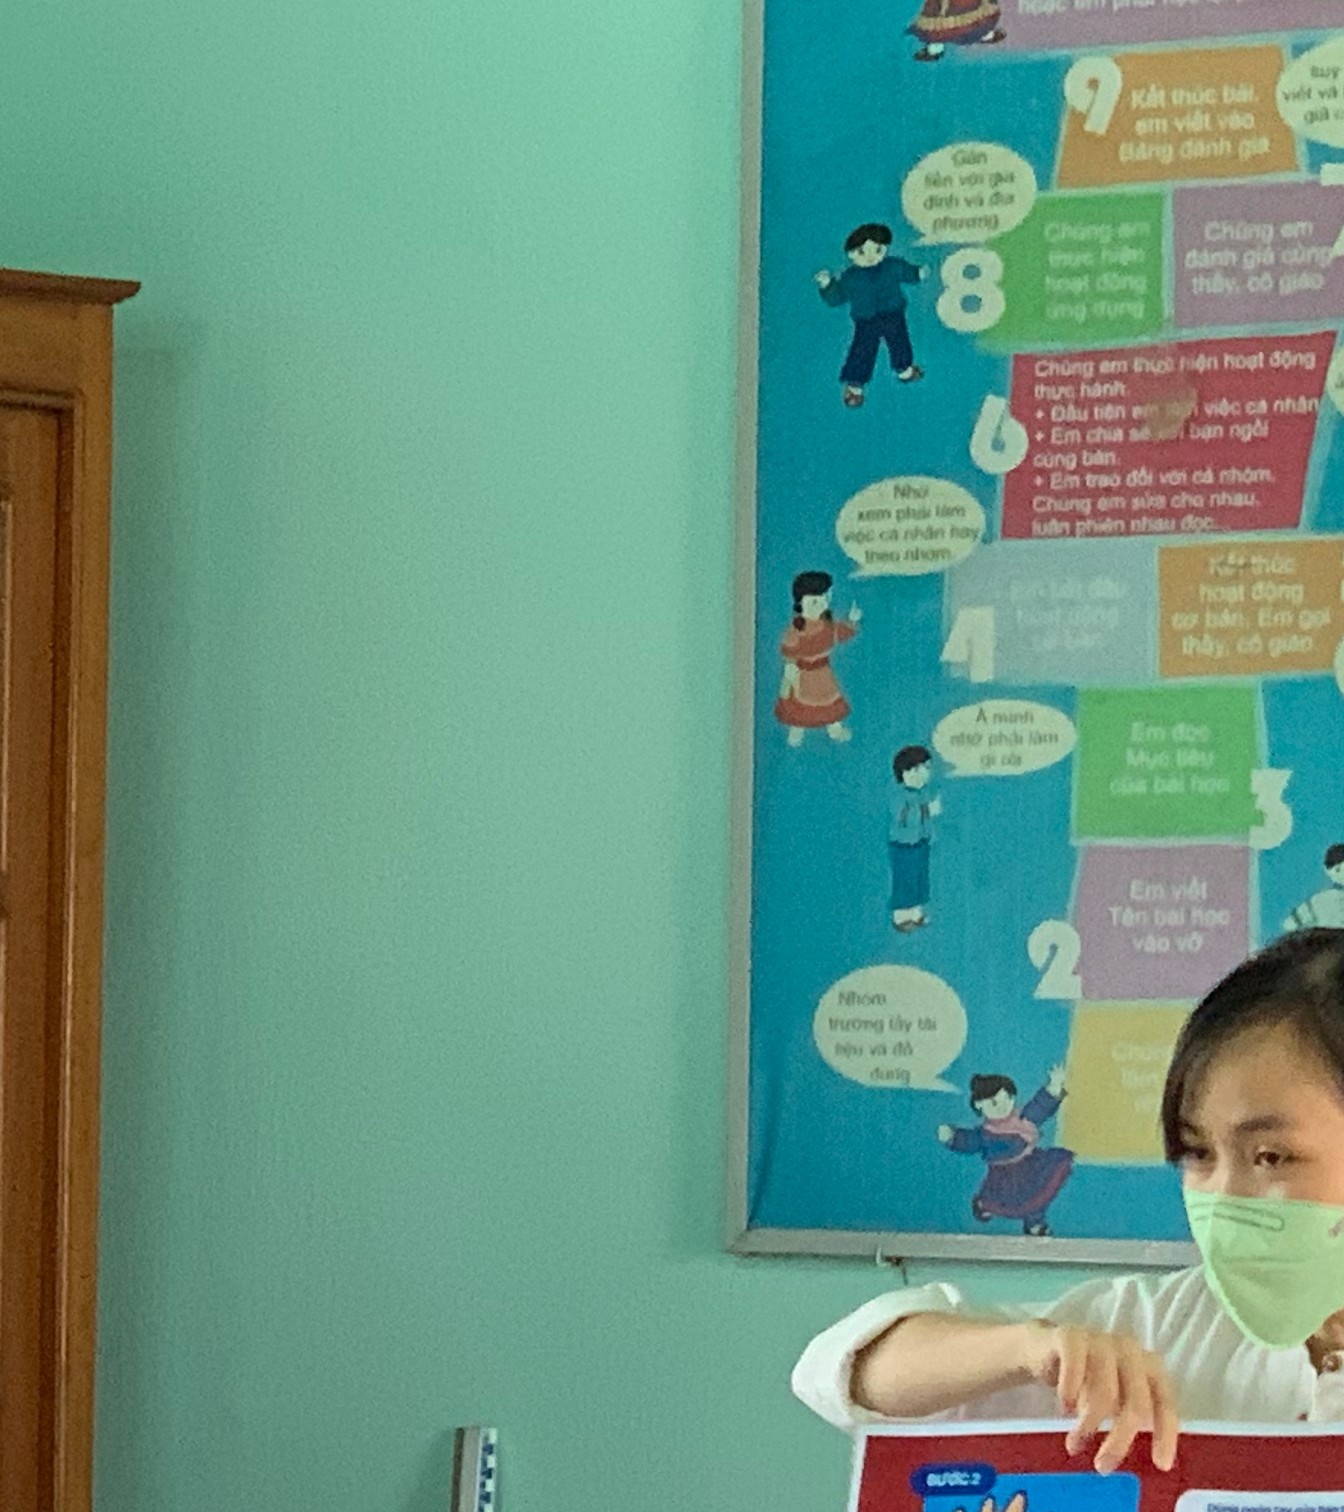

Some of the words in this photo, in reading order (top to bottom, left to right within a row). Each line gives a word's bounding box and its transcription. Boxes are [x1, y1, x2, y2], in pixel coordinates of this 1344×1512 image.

[1064, 55, 1123, 135] 9
[936, 248, 1006, 333] 8
[969, 394, 1029, 474] 6
[940, 605, 994, 683] 4
[1249, 768, 1293, 850] 3
[1028, 919, 1083, 999] 2
